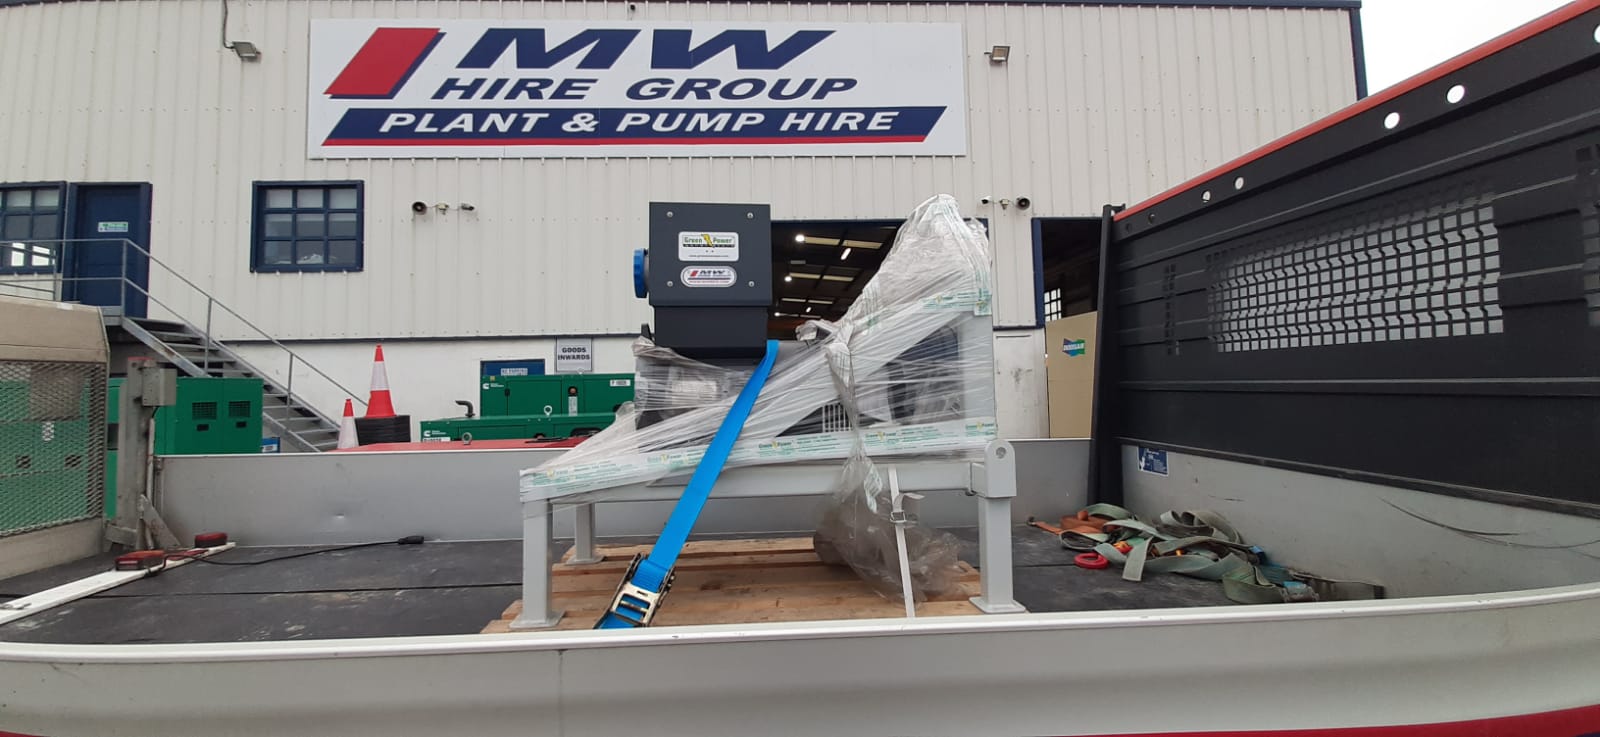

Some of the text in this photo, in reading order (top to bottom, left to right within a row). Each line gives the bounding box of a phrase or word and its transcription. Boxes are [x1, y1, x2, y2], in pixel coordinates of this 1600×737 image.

[456, 27, 836, 71] MW
[430, 77, 858, 101] HIRE GROUP
[379, 111, 899, 133] PLANT & PUMP HIRE
[557, 353, 591, 361] INWARDS
[561, 346, 587, 354] GOODS
